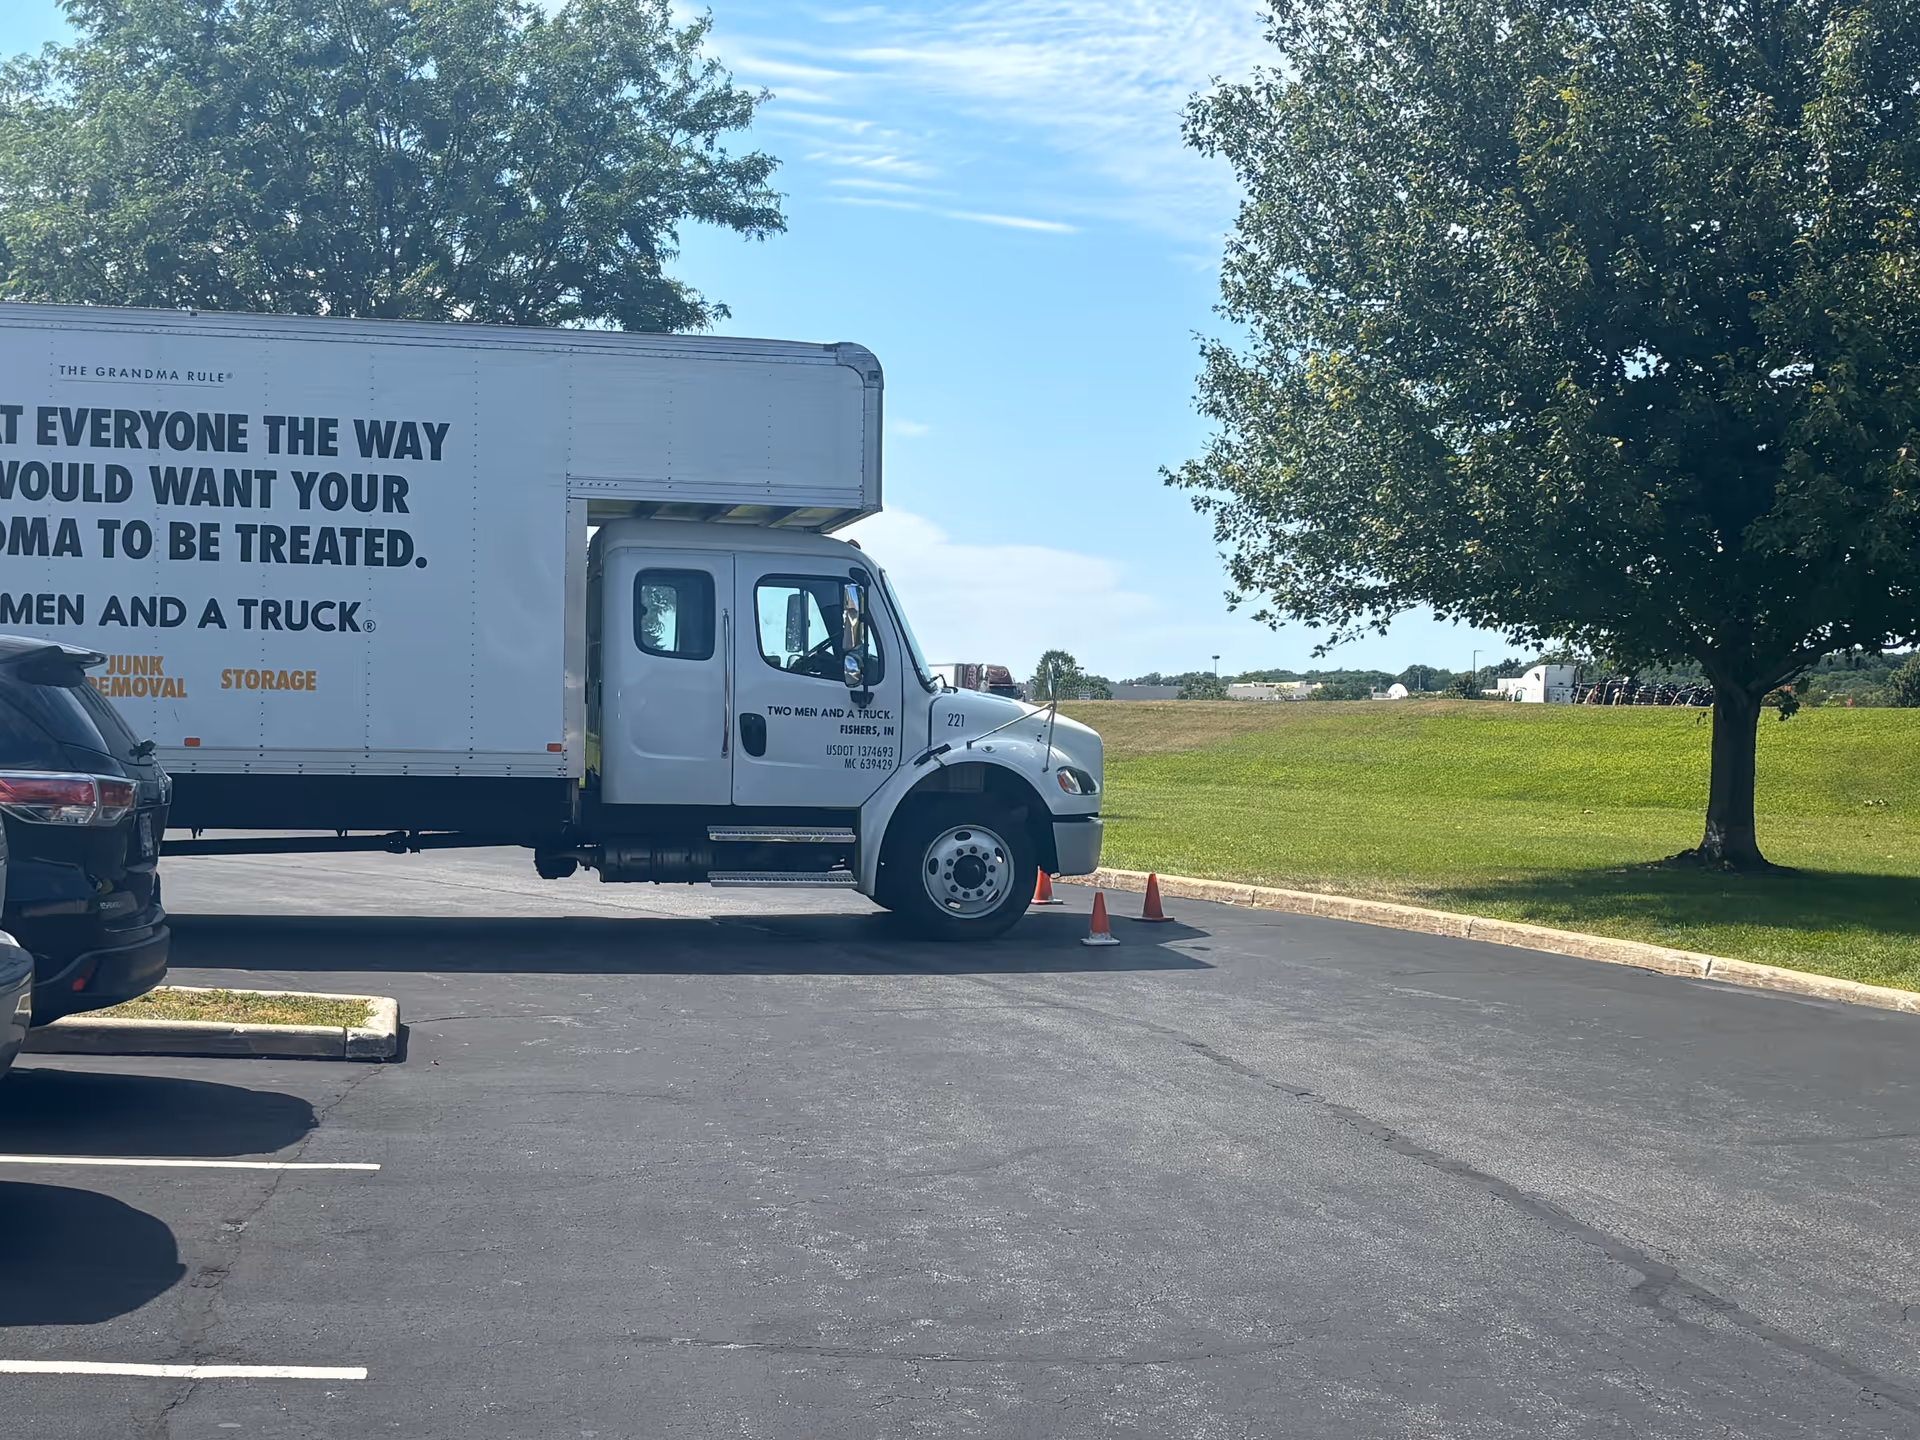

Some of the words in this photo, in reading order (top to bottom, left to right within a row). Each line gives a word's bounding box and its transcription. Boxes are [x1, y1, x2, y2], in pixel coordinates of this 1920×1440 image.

[59, 365, 87, 376] THE
[95, 366, 180, 381] GRANDMA
[0, 405, 24, 444] T
[36, 406, 248, 453] EVERYONE
[263, 415, 339, 456] THE
[354, 419, 450, 461] WAY
[149, 465, 277, 508] WANT
[291, 471, 410, 514] YOUR
[0, 516, 83, 557] MA
[97, 519, 153, 560] TO
[169, 521, 220, 561] BE
[235, 523, 428, 569] TREATED.
[0, 592, 85, 625] MEN
[98, 595, 187, 628] AND
[198, 598, 227, 630] A
[105, 655, 164, 676] JUNK
[220, 669, 317, 691] STORAGE
[767, 705, 792, 716] TWO
[794, 707, 818, 717] MEN
[820, 708, 844, 718] AND
[846, 709, 855, 719] A
[947, 713, 965, 727] 221
[840, 724, 881, 737] FISHERS,
[883, 726, 894, 736] IN
[826, 744, 854, 756] USDOT
[857, 745, 894, 757] 1374693
[844, 758, 857, 769] MC
[860, 758, 893, 770] 639429
